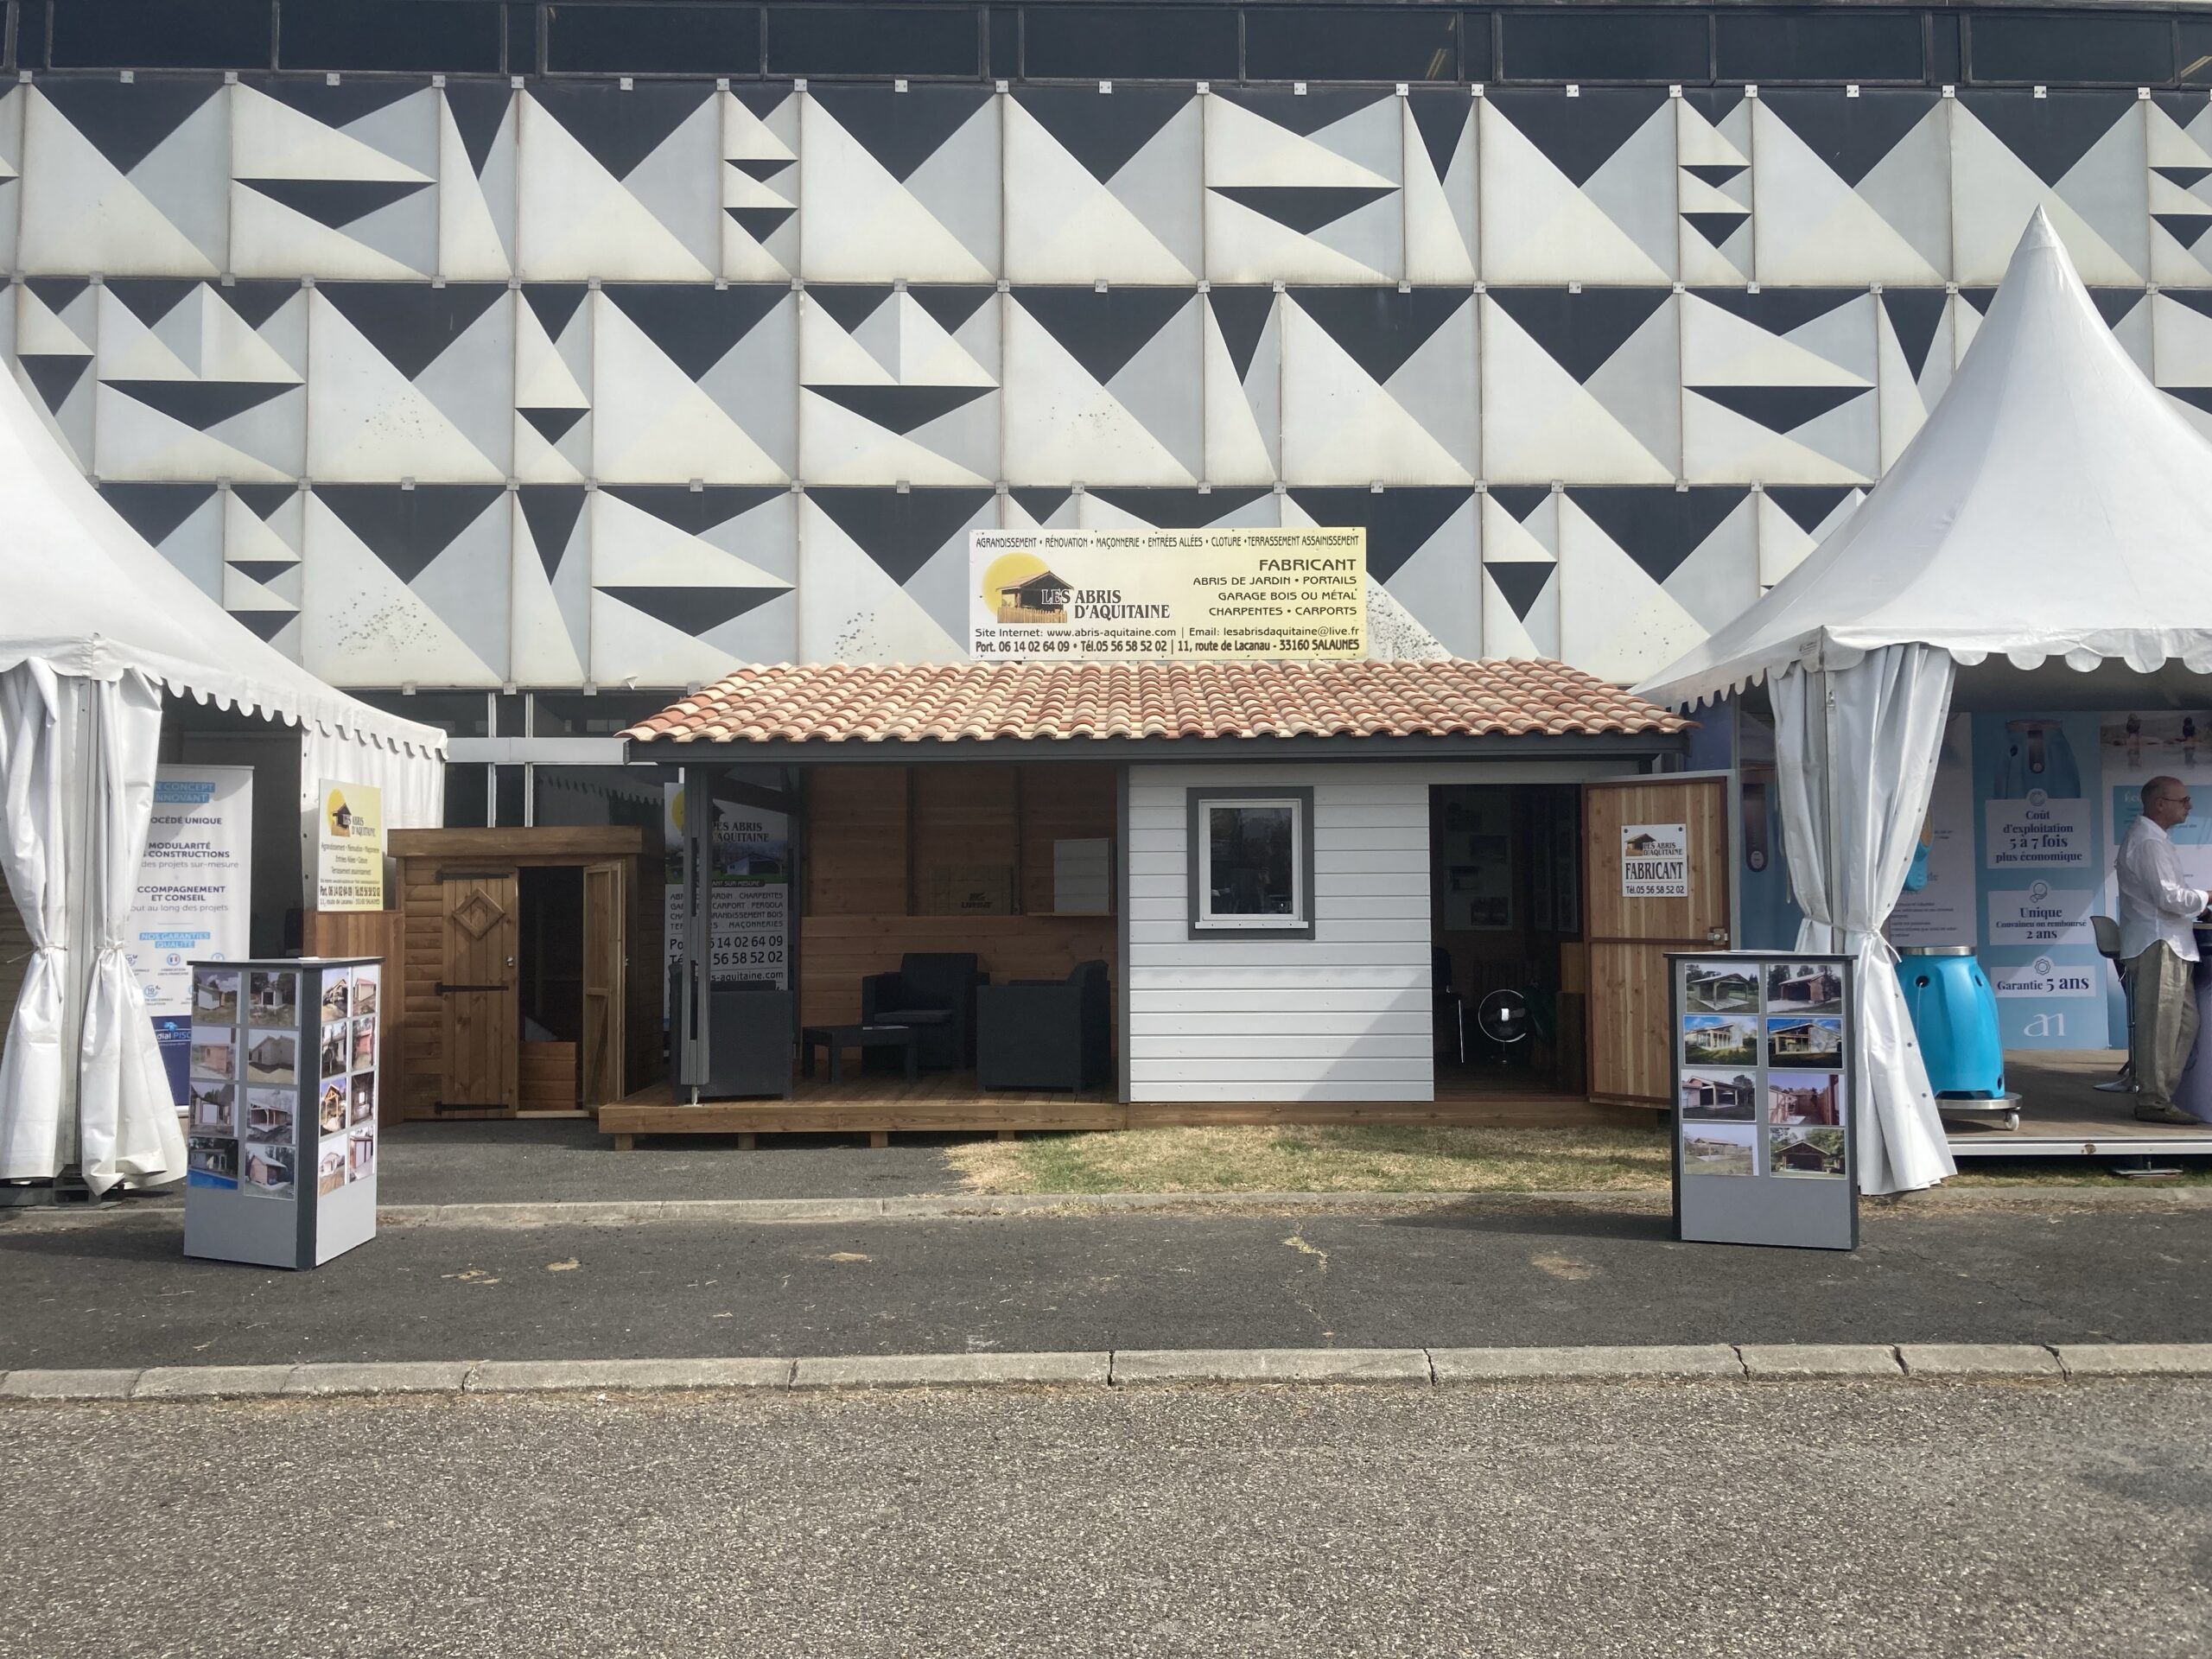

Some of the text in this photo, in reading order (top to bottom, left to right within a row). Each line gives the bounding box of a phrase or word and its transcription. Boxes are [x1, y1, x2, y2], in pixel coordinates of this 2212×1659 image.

[976, 534, 1359, 550] AGRANDISSEMENT RÉNOVATION MAÇONNERIE ENTRÉES ALLÉES CLOTURE TERRASSEMENT ASSAINISSEMENT
[1259, 558, 1357, 571] FABRICANT
[1192, 575, 1357, 586] ABRIS DE JARDIN PORTAILS
[1041, 589, 1122, 604] LES ABRIS
[1217, 589, 1357, 601] GARAGE BOIS OU MÉTAL
[1074, 604, 1171, 621] D'AQUITAINE
[1209, 607, 1357, 616] CHARPENTES CARPORTS
[975, 626, 1360, 639] Site Internet: www.abris-aquitaine.com Email: lesabrisdaquitaine@live.fr
[976, 641, 995, 652] Port.
[999, 641, 1011, 652] 06
[1014, 641, 1027, 652] 14
[1028, 641, 1040, 652] 02
[1043, 641, 1055, 652] 64
[1057, 641, 1070, 652] 09
[1110, 641, 1123, 652] 56
[1125, 641, 1138, 652] 58
[1140, 641, 1153, 652] 52
[1154, 641, 1167, 652] 02
[1178, 640, 1192, 653] 11,
[1195, 641, 1217, 652] route
[1220, 640, 1232, 651] de
[1235, 640, 1270, 651] Lacanau
[1280, 639, 1309, 651] 33160
[1312, 639, 1360, 650] SALAUNES
[163, 782, 214, 791] CONCEPT
[154, 793, 208, 803] NNOVANT
[150, 815, 182, 824] OCÉDÉ
[2025, 810, 2050, 820] Coût
[733, 822, 762, 831] ABRIS
[2003, 823, 2074, 835] d'exploitation
[2010, 834, 2068, 849] 5 à 7 fois
[149, 850, 231, 859] CONSTRUCTIONS
[1996, 851, 2082, 863] plus économique
[159, 861, 188, 869] projets
[1624, 861, 1683, 880] FABRICANT
[161, 905, 180, 913] long
[200, 905, 229, 913] projets
[2019, 906, 2063, 920] Unique
[2026, 930, 2057, 939] 2 ans
[717, 938, 731, 948] 14
[734, 937, 748, 947] 02
[751, 936, 766, 947] 64
[768, 936, 783, 946] 09
[714, 952, 728, 964] 56
[732, 952, 747, 964] 58
[750, 951, 765, 963] 52
[768, 950, 783, 963] 02
[1997, 977, 2089, 992] Garantie 5 ans
[156, 1031, 171, 1040] dial
